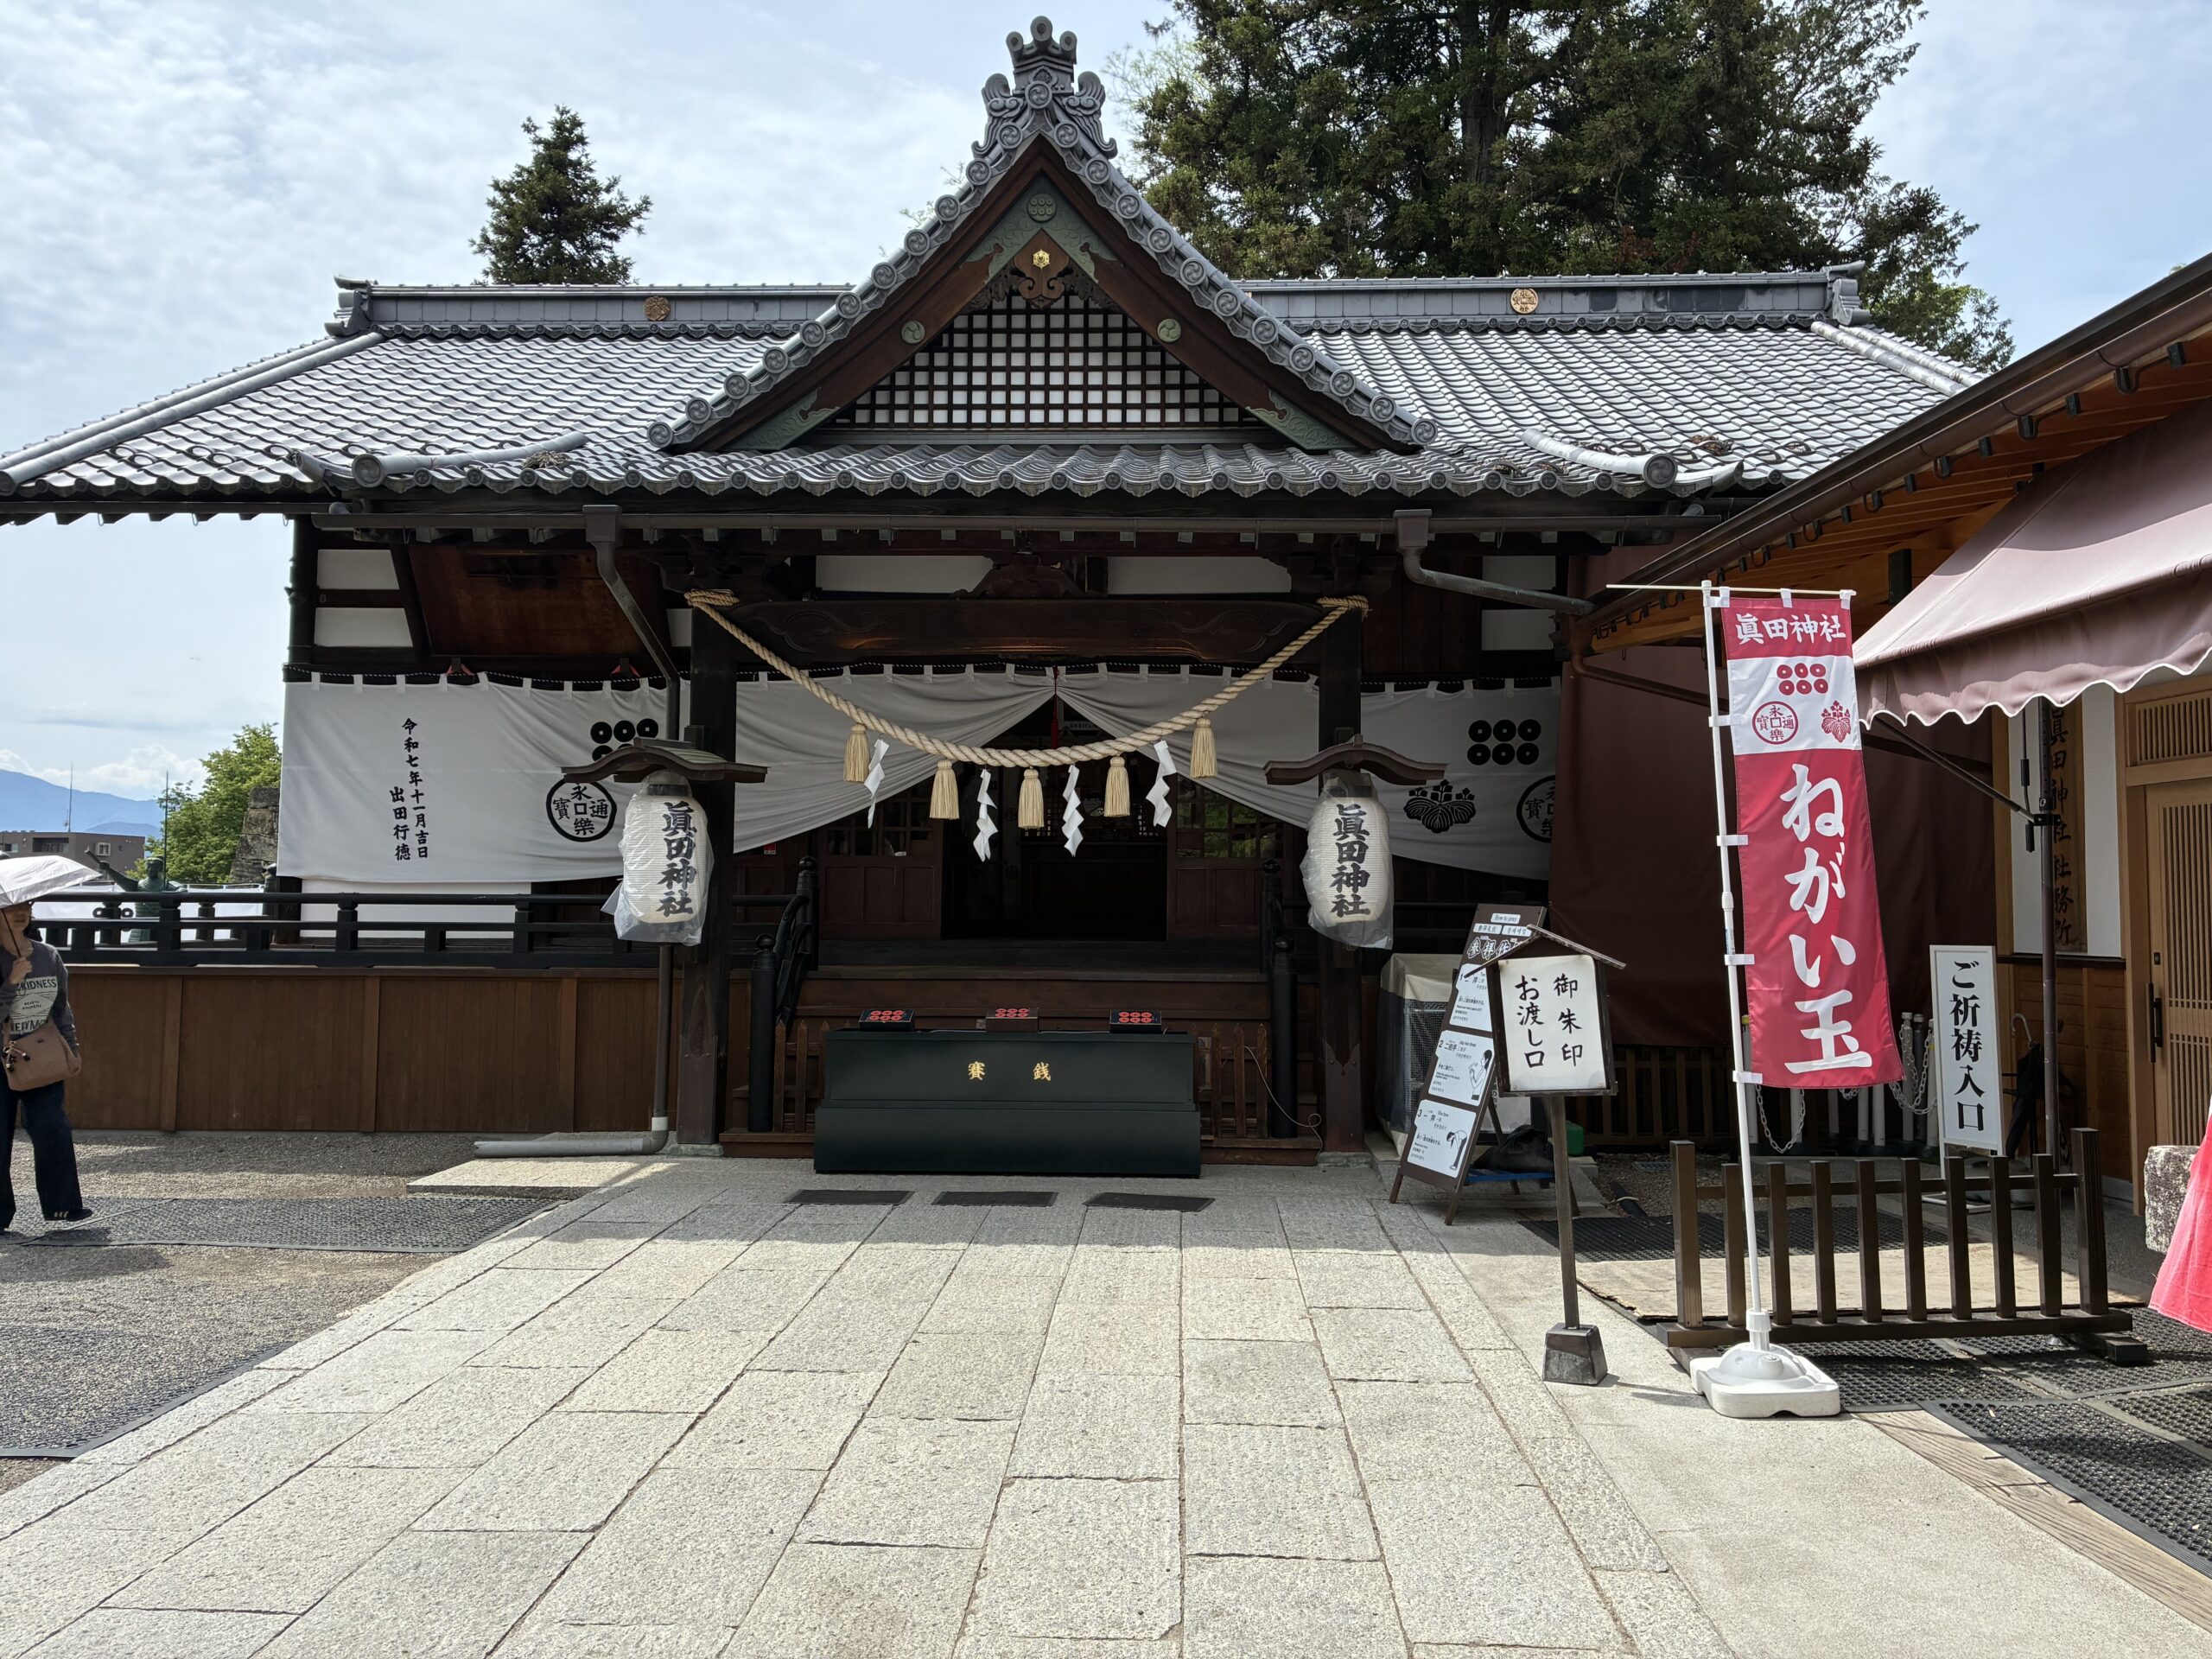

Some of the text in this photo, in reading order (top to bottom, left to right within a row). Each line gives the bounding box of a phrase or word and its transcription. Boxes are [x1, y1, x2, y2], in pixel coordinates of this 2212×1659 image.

[1735, 613, 1847, 645] 眞田神社
[402, 717, 429, 859] 令和七年十一月吉日
[1780, 763, 1872, 1074] ねがい玉
[1515, 975, 1545, 1068] お渡し口
[1553, 972, 1583, 1067] 御朱印
[1949, 960, 1985, 1131] ご祈祷入口
